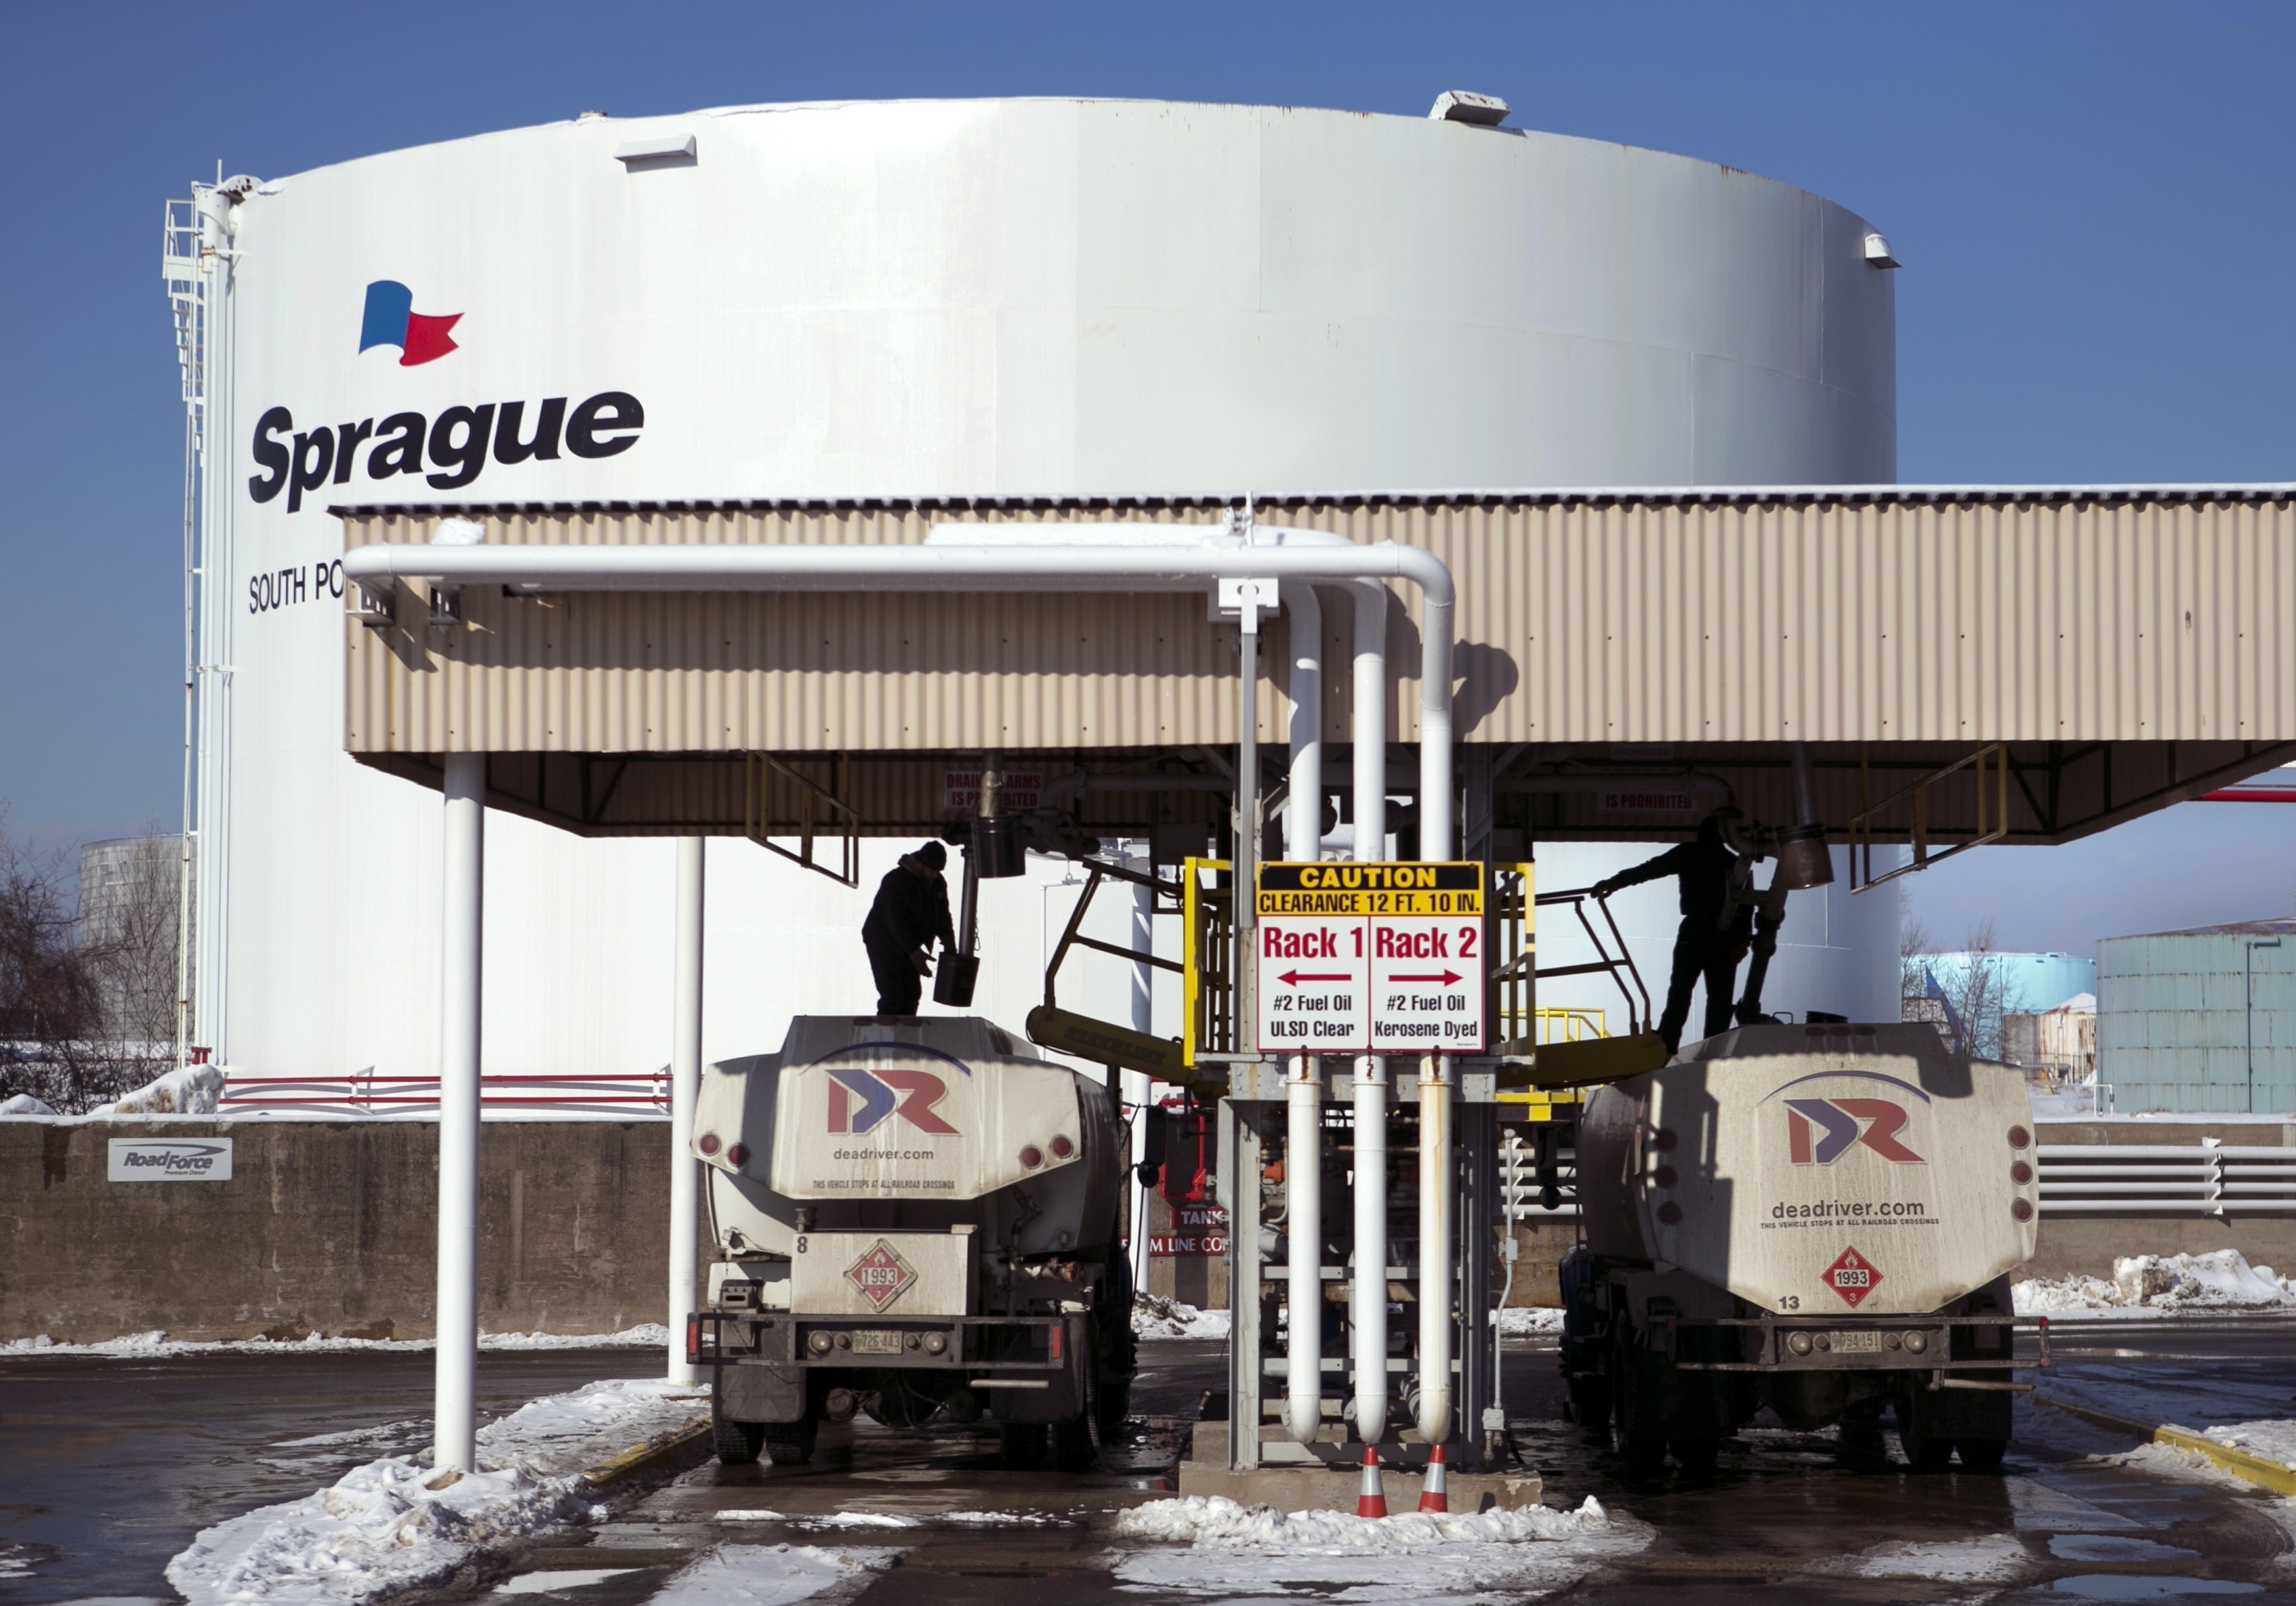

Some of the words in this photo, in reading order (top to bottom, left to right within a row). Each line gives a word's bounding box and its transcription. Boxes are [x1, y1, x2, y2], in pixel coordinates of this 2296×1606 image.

[248, 390, 645, 514] Sprague
[249, 566, 306, 615] SOUTH
[1006, 775, 1041, 789] ARMS
[951, 791, 964, 806] IS
[967, 791, 1037, 806] PRBITED
[1606, 794, 1618, 808] IS
[1621, 794, 1692, 809] PROHIBITED
[1299, 867, 1437, 888] CAUTION
[1259, 894, 1359, 913] CLEARANCE
[1367, 894, 1389, 912] 12
[1395, 894, 1420, 912] FT.
[1429, 894, 1450, 912] 10
[1458, 894, 1480, 912] IN.
[1264, 927, 1337, 958] Rack
[1350, 927, 1363, 958] 1
[1376, 927, 1448, 958] Rack
[1458, 927, 1477, 958] 2
[1273, 995, 1292, 1011] #2
[1298, 995, 1328, 1011] Fuel
[1333, 995, 1352, 1011] Oil
[1387, 995, 1406, 1011] #2
[1412, 995, 1441, 1011] Fuel
[1447, 995, 1465, 1011] Oil
[1271, 1021, 1308, 1037] ULSD
[1313, 1021, 1354, 1037] Clear
[1375, 1021, 1439, 1037] Kerosene
[1444, 1021, 1477, 1039] Dyed
[1063, 1026, 1167, 1065] GREENLINE
[123, 1151, 213, 1170] RoadForce
[833, 1147, 934, 1160] deadriver.com
[813, 1180, 825, 1189] THIS
[827, 1180, 849, 1189] VEHICLE
[852, 1180, 869, 1189] STOPS
[872, 1180, 878, 1189] AT
[881, 1180, 890, 1189] ALL
[892, 1180, 920, 1189] RAILROAD
[923, 1180, 955, 1189] CROSSINGS
[1181, 1211, 1224, 1224] TANK
[1771, 1199, 1924, 1220] deadriver.com
[797, 1236, 808, 1254] 8
[1168, 1238, 1195, 1252] LINE
[863, 1269, 896, 1284] 1993
[1836, 1271, 1868, 1285] 1993
[876, 1290, 882, 1298] 3
[1849, 1293, 1856, 1302] 3
[1779, 1296, 1800, 1309] 13
